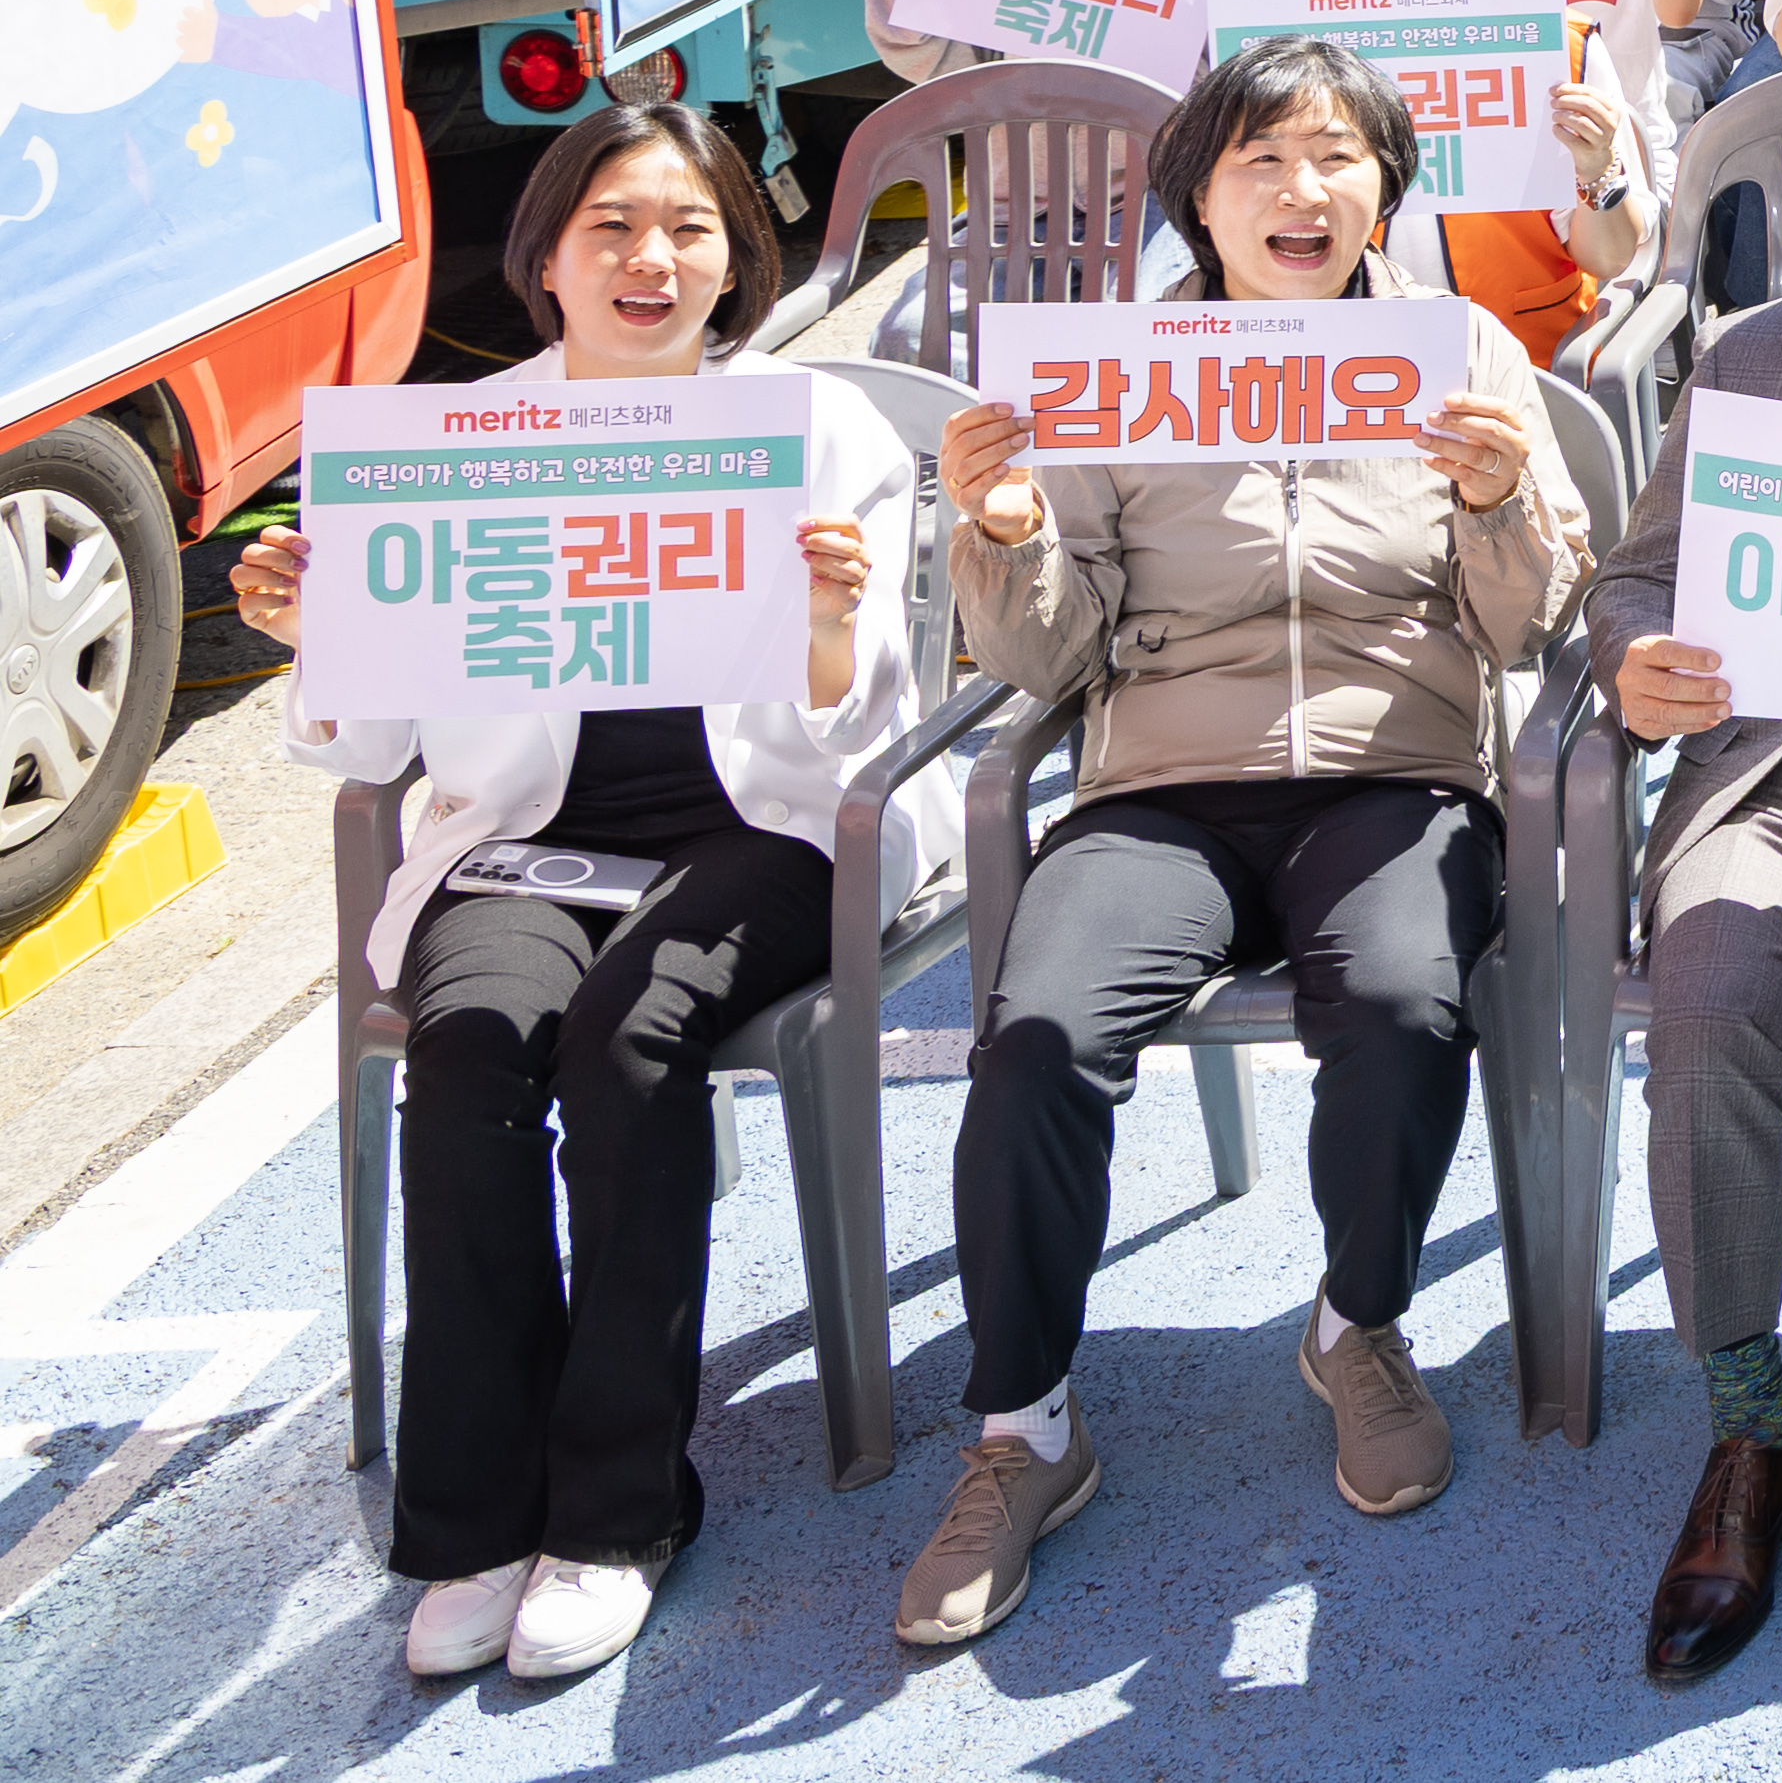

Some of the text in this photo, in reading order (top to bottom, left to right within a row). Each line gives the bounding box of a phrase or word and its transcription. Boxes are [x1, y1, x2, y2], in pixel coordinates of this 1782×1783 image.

[1152, 313, 1305, 336] meritz 메리츠화재
[443, 400, 673, 434] meritz 메리츠화재
[1030, 354, 1423, 450] 감사해요
[345, 448, 772, 491] 어린이가 행복하고 안전한 우리 마을
[365, 508, 745, 605] 아동권리
[463, 601, 650, 690] 축제
